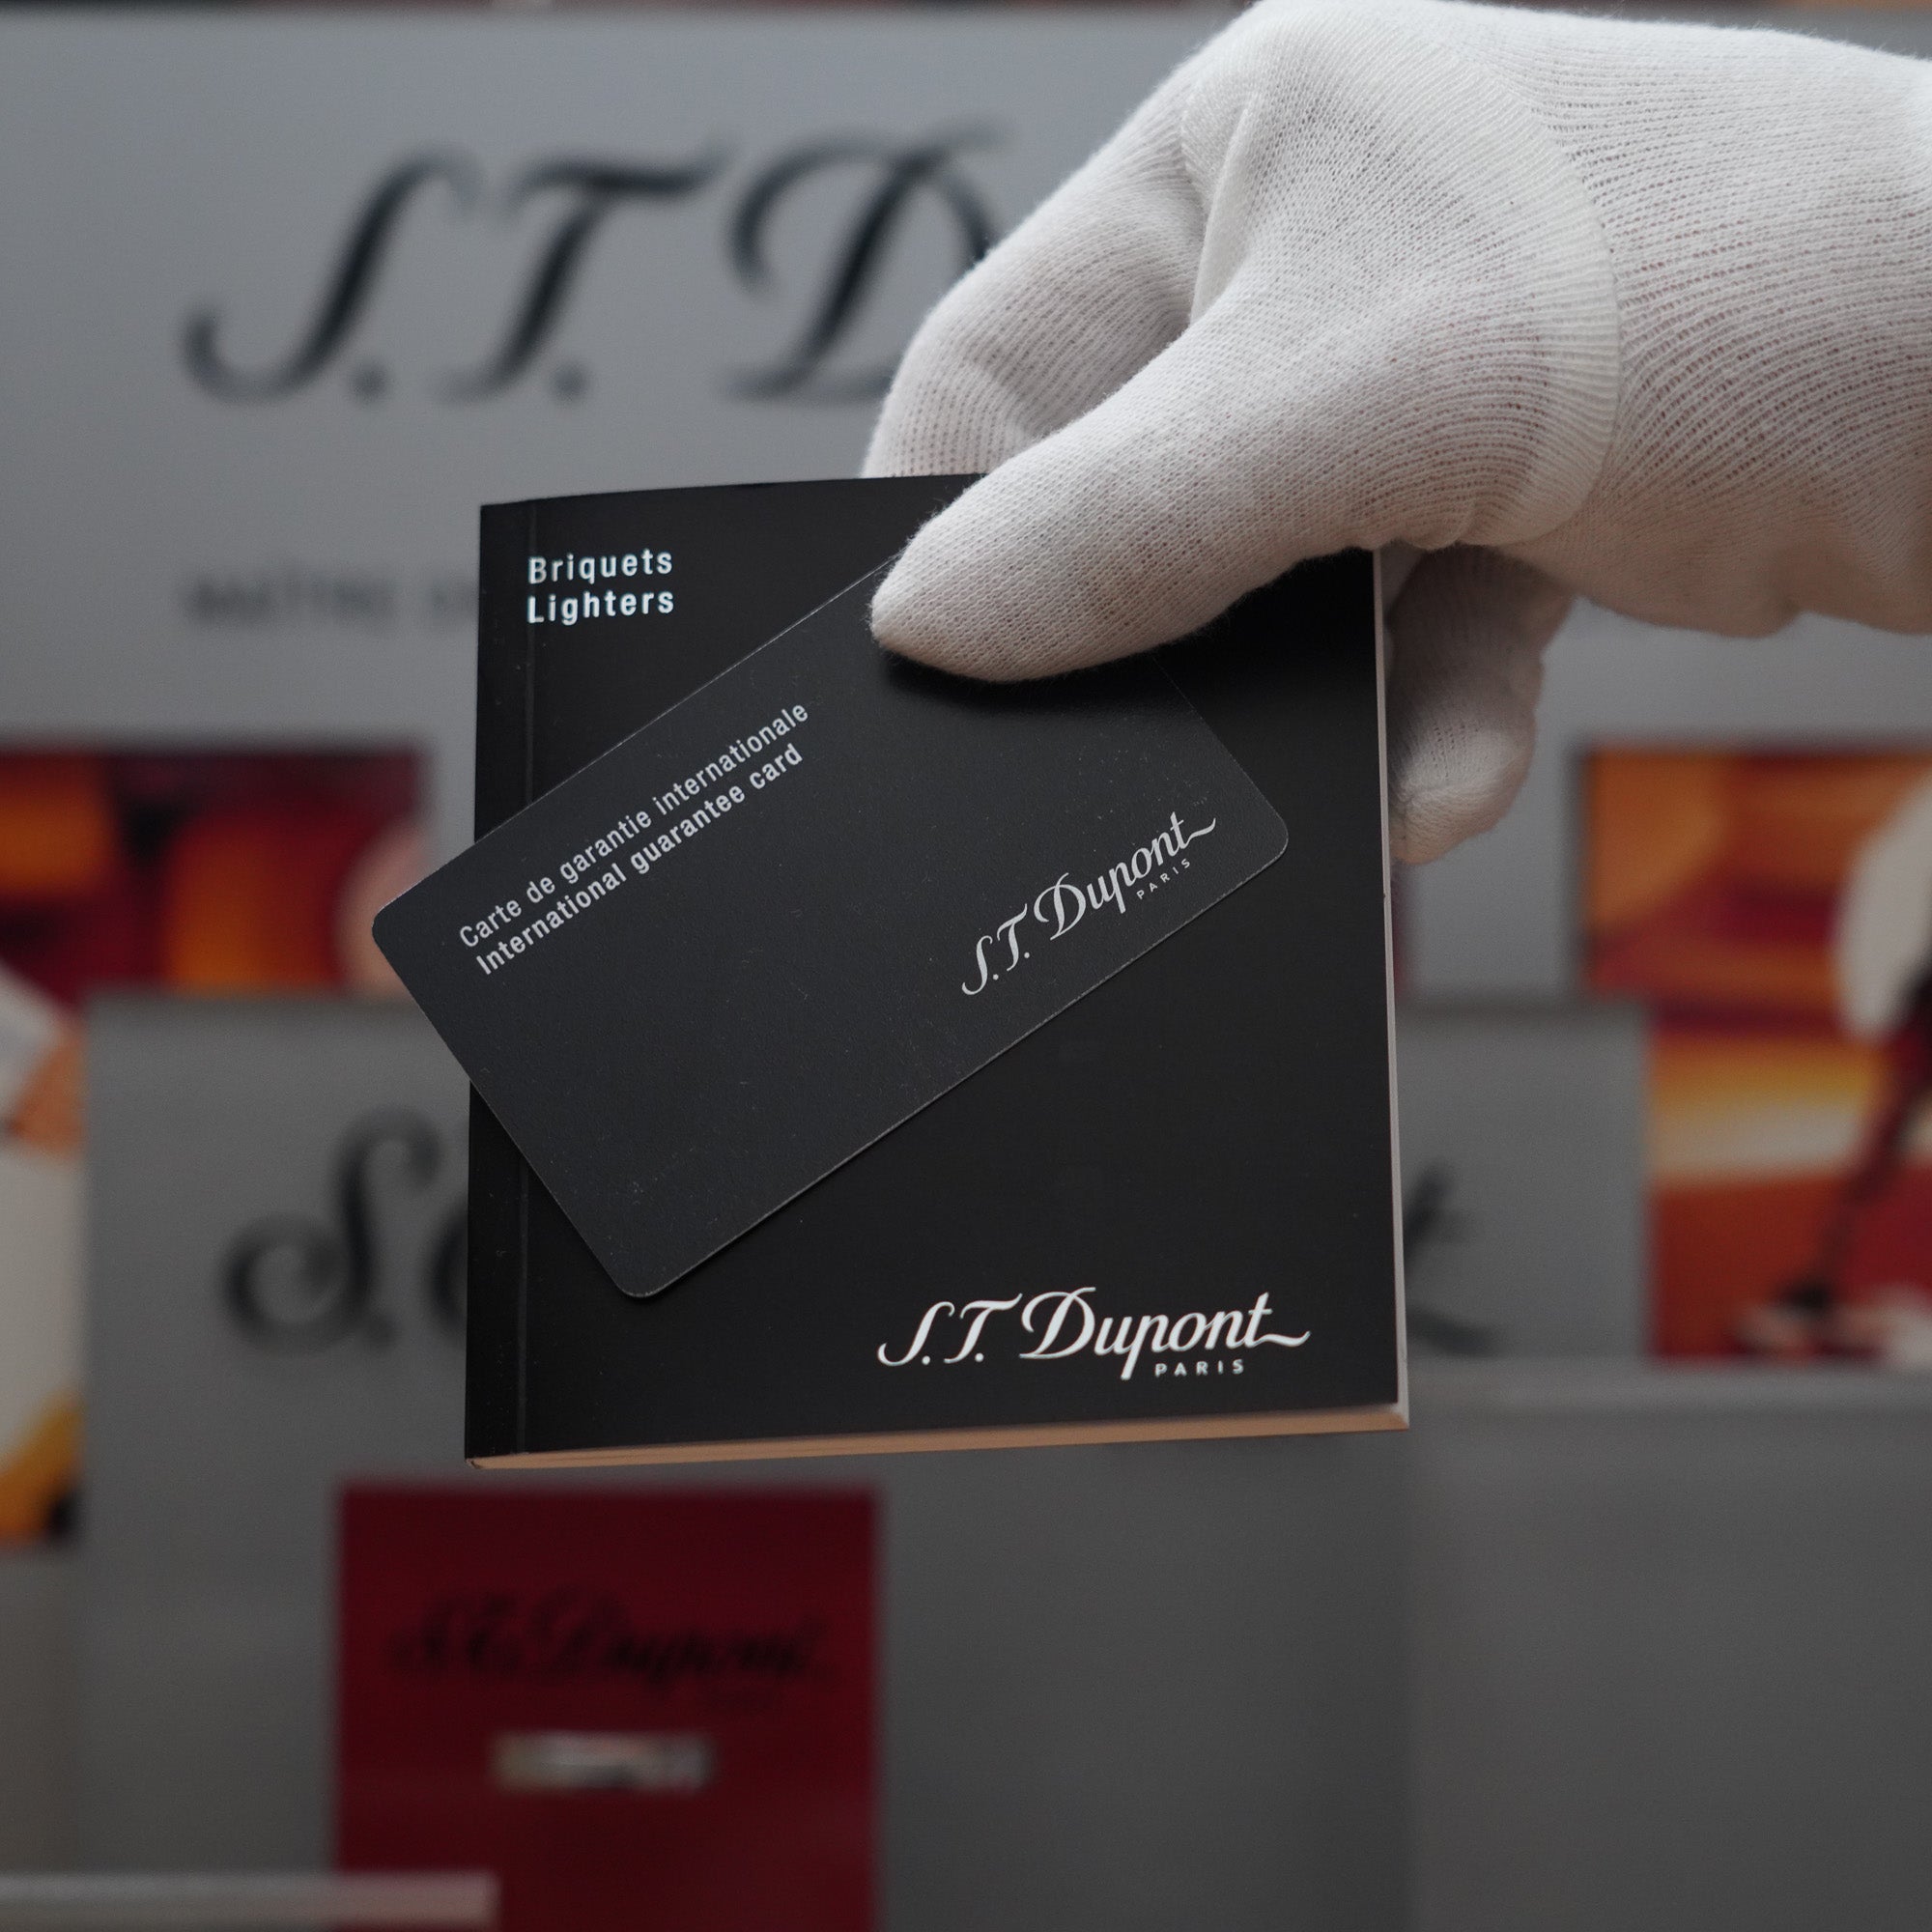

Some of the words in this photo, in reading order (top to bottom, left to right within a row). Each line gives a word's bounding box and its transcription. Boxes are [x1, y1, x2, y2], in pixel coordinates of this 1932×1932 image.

[528, 548, 672, 584] Briquets
[527, 590, 674, 626] Lighters
[459, 899, 523, 948] Carte
[526, 875, 555, 903] de
[560, 810, 652, 884] garantie
[652, 703, 809, 816] internationale
[475, 862, 627, 976] International
[630, 784, 746, 874] guarantee
[749, 742, 804, 790] card
[961, 902, 1031, 996] S.T.
[1034, 810, 1216, 941] Dupont
[1136, 858, 1191, 900] PARIS
[877, 1293, 1022, 1367] S.T.
[1019, 1286, 1311, 1381] Dupont
[1154, 1358, 1245, 1378] PARIS
